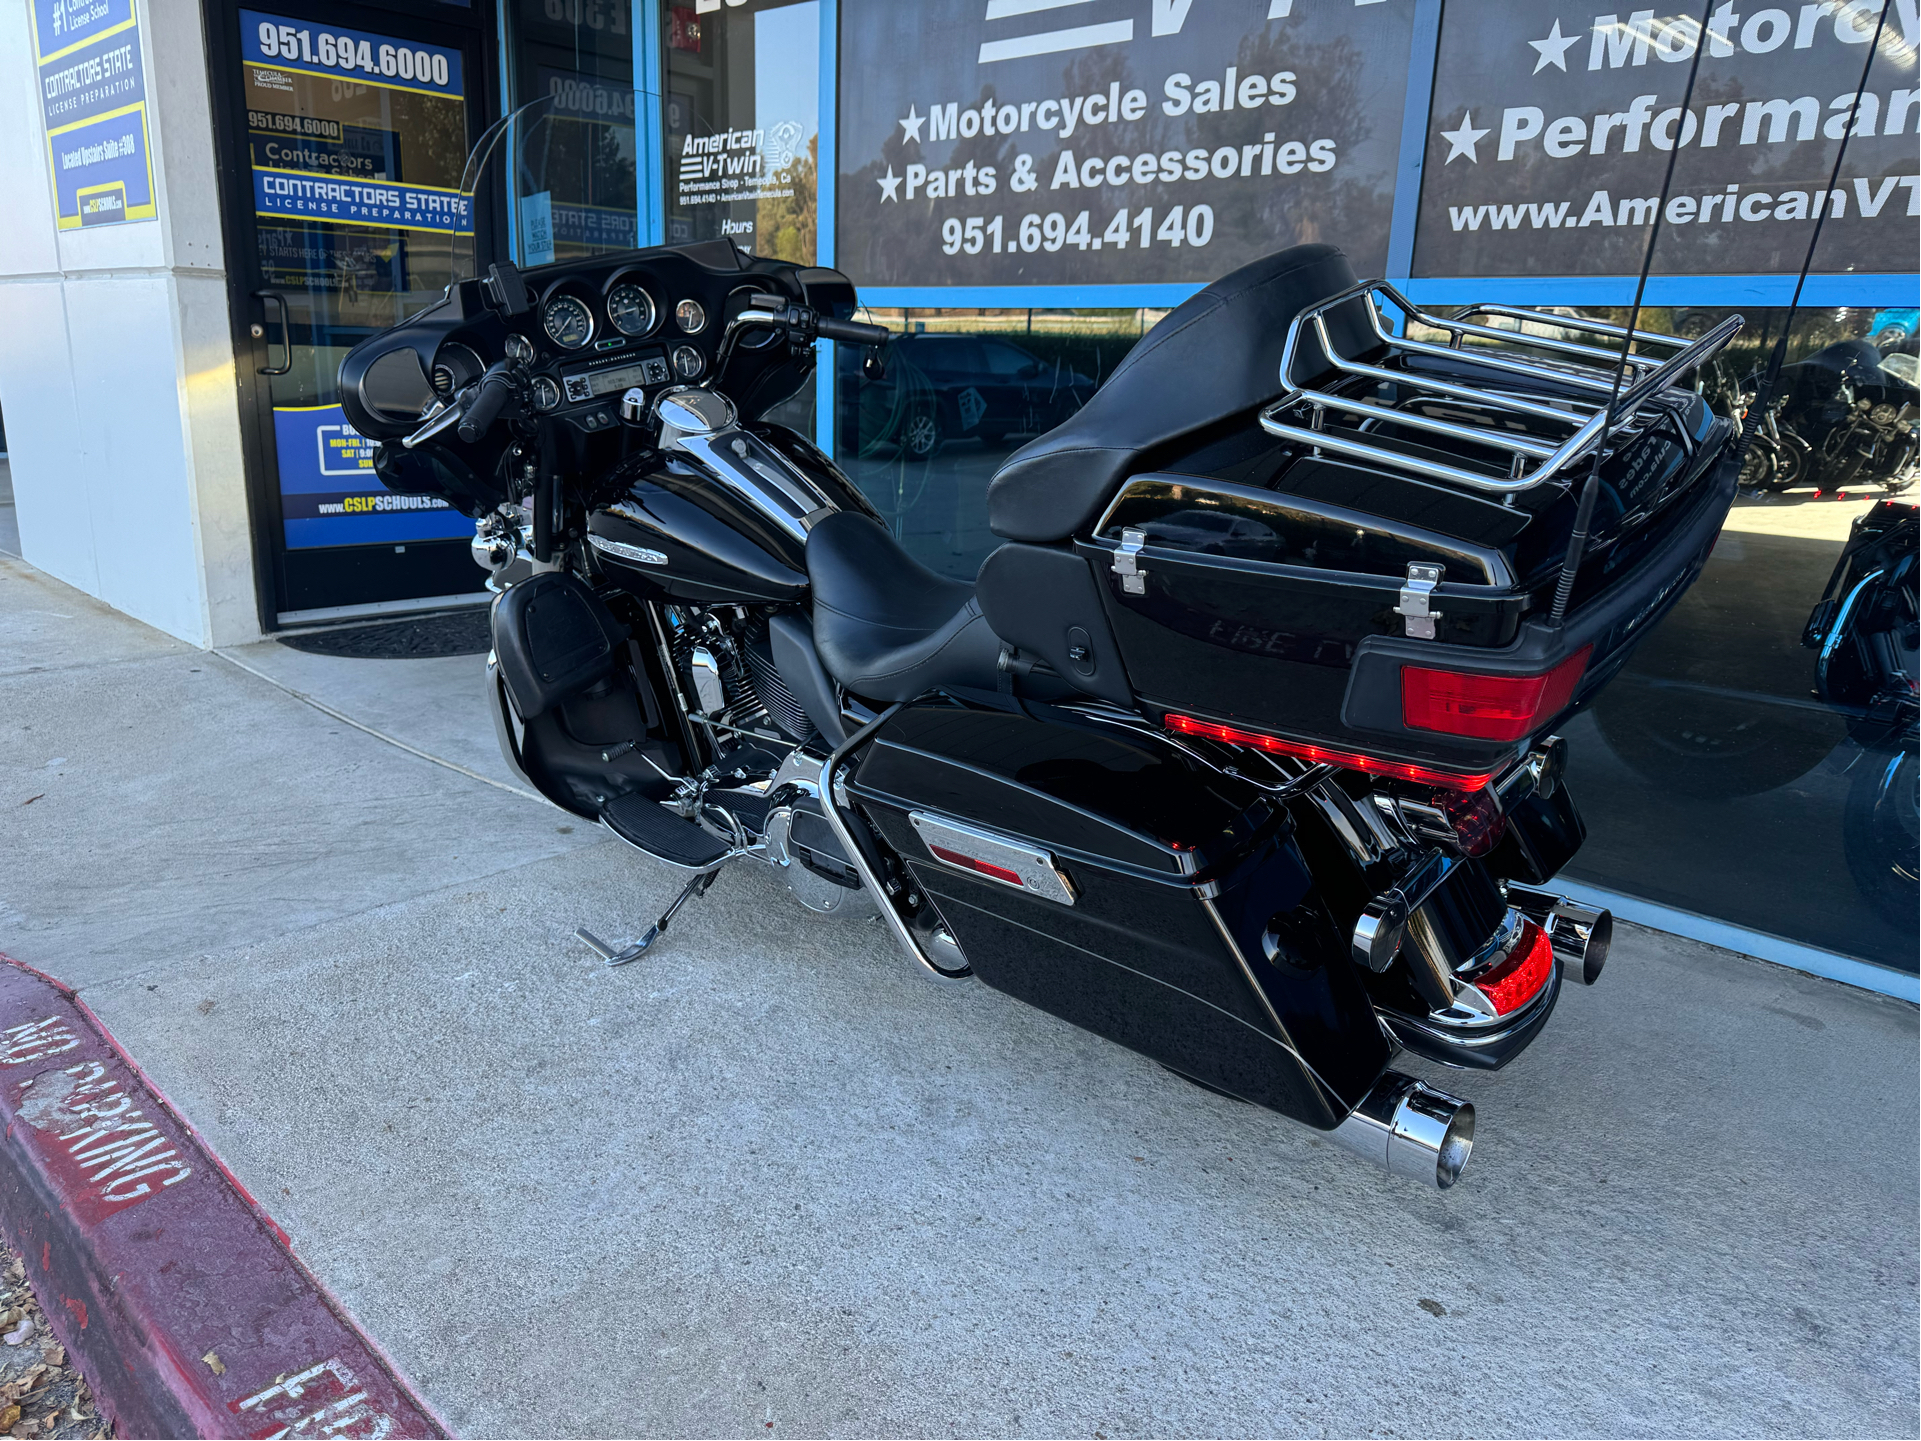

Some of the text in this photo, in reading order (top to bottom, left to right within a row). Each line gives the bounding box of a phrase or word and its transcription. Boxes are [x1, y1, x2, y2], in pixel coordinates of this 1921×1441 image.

[69, 0, 109, 31] License School
[258, 22, 449, 86] 951.694.6000
[45, 45, 133, 99] CONTRACTORS STATE
[48, 76, 136, 117] LICENSE PREPARATION
[928, 67, 1297, 141] Motorcycle Sales
[248, 111, 338, 137] 951.694.6000
[62, 148, 82, 170] Located
[81, 143, 103, 167] Upstairs
[103, 139, 119, 160] Suite
[265, 142, 373, 170] Contractors
[682, 127, 764, 156] American
[702, 150, 761, 178] V-Twin
[905, 132, 1337, 200] Parts & Accessories
[263, 176, 400, 207] CONTRACTORS
[679, 181, 720, 193] Performance
[722, 178, 739, 189] Shop
[781, 172, 791, 183] Ca
[265, 197, 467, 226] LICENSE PREPARATION
[721, 219, 753, 235] Hours
[941, 203, 1214, 256] 951.694.4140
[342, 450, 355, 458] SAT
[318, 495, 449, 514] www.CSLPSCHOOLS.com
[0, 1016, 80, 1064] NO
[18, 1062, 191, 1202] PARKING
